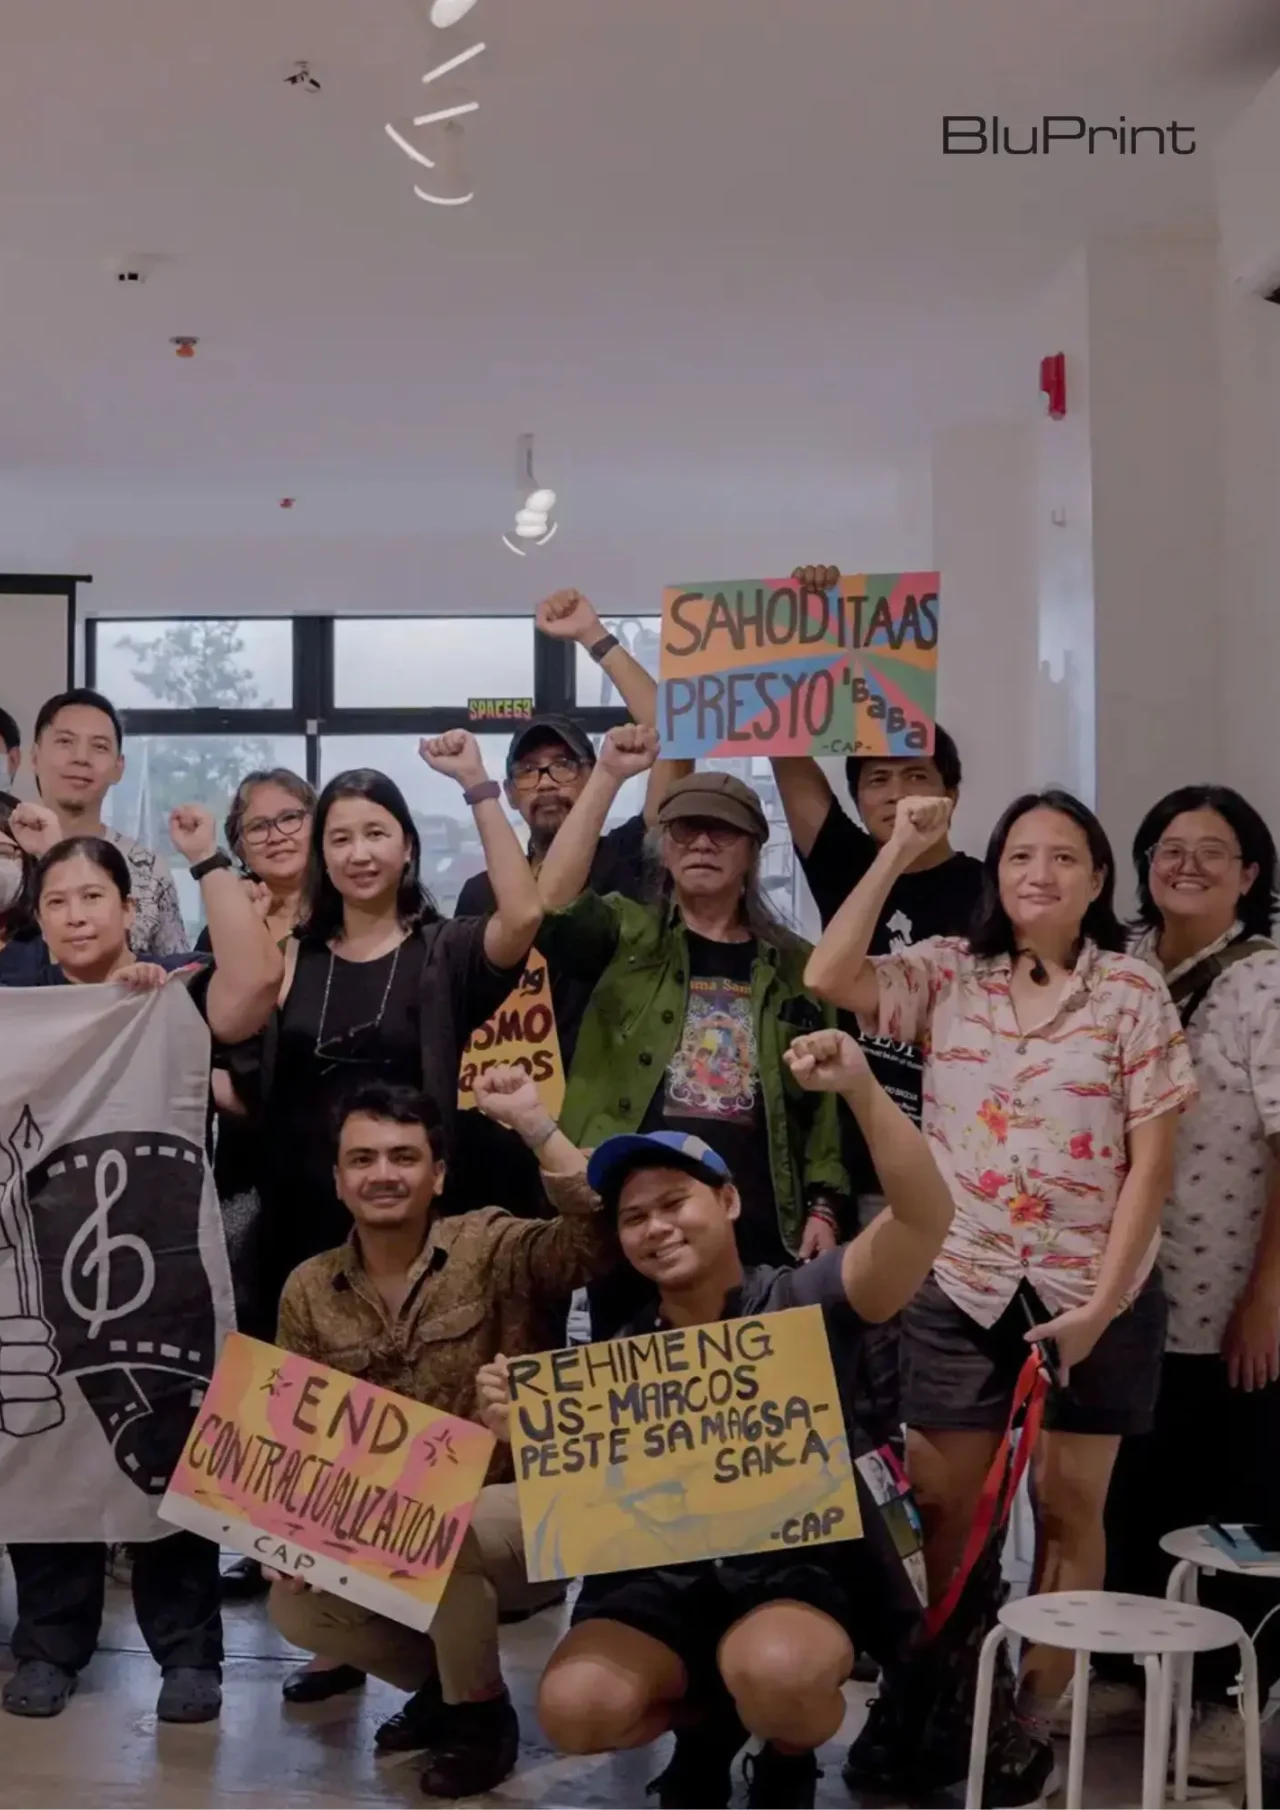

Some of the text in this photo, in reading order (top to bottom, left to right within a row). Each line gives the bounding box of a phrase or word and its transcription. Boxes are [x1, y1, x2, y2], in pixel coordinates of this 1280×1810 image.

[665, 586, 939, 657] SAHOD ITAAS
[665, 668, 835, 742] PRESYO
[507, 1320, 774, 1400] REHIMENG
[292, 1375, 409, 1455] END
[518, 1365, 760, 1443] US-MARCOS
[520, 1427, 631, 1481] PESTE
[643, 1419, 695, 1457] SA
[713, 1429, 830, 1484] SAKA
[188, 1413, 461, 1569] CONTRACTUALIZATION
